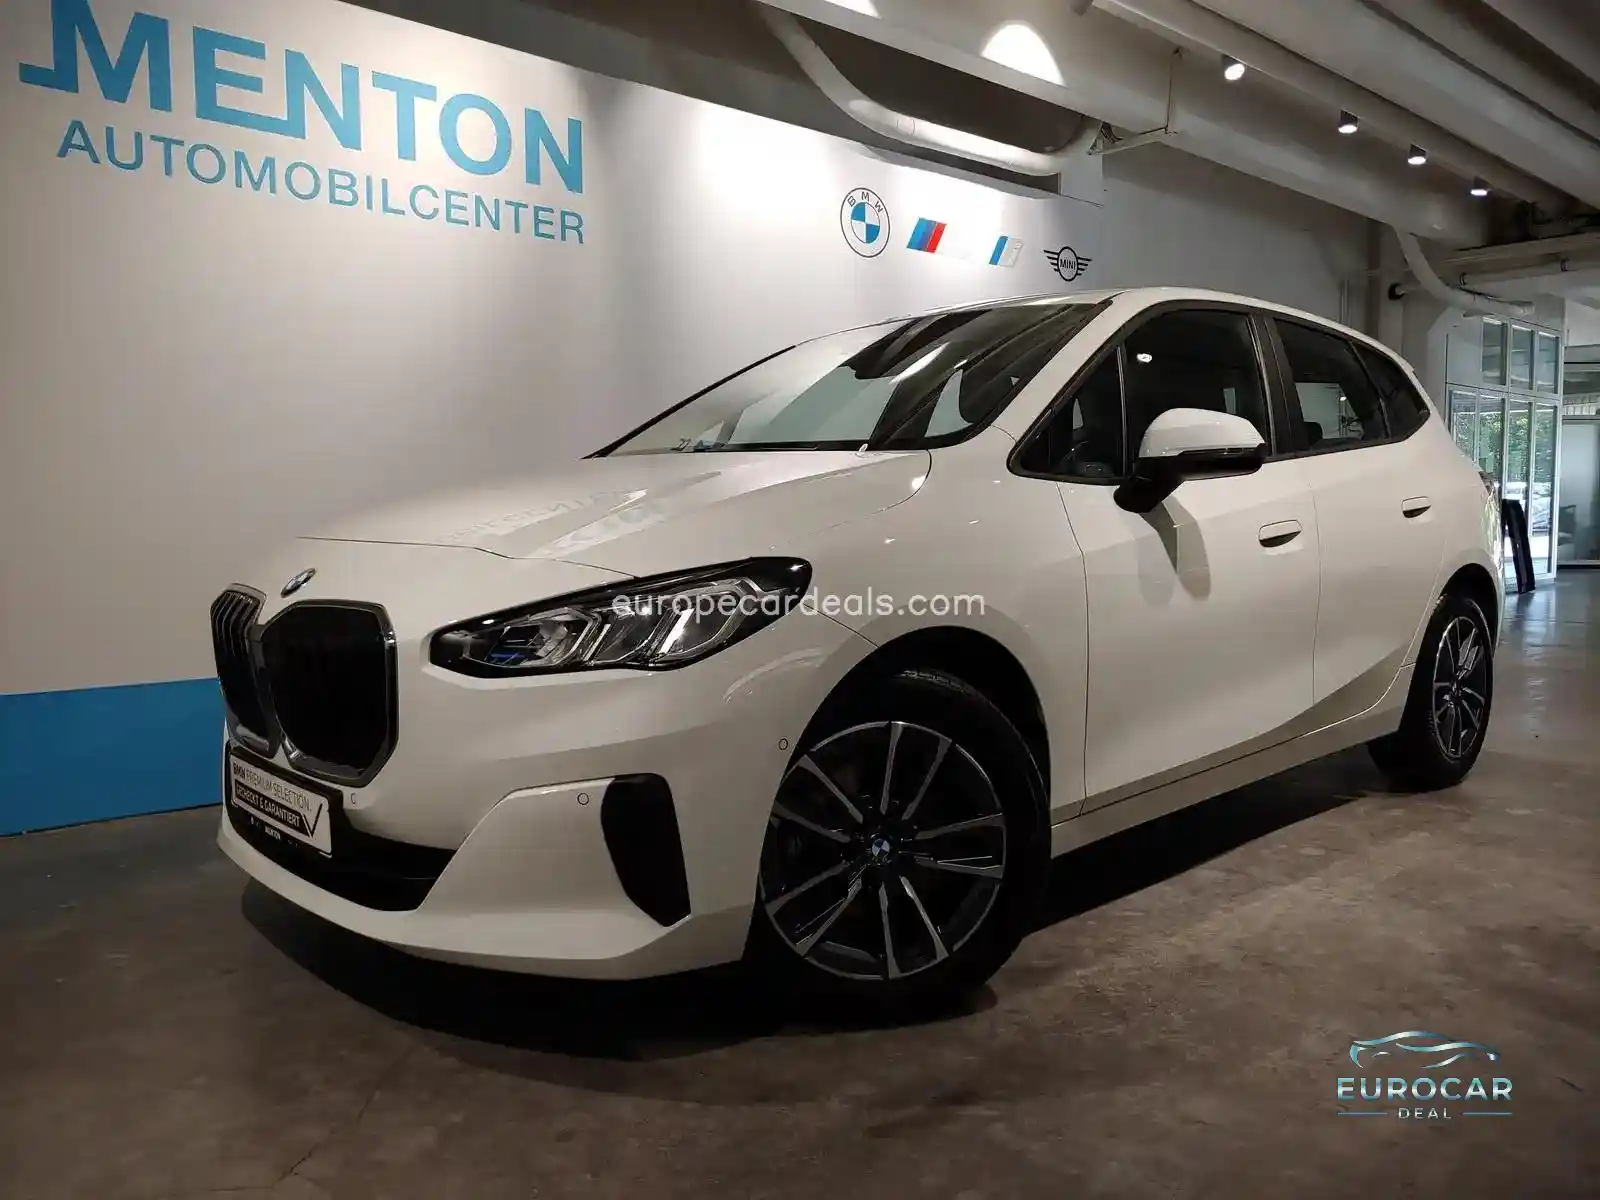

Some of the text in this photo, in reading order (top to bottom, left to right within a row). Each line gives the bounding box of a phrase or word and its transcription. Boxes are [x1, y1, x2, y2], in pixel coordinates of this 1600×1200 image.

[19, 0, 584, 194] MENTON
[57, 119, 585, 245] AUTOMOBILCENTER
[847, 191, 882, 213] BMW
[1059, 259, 1076, 270] MINI
